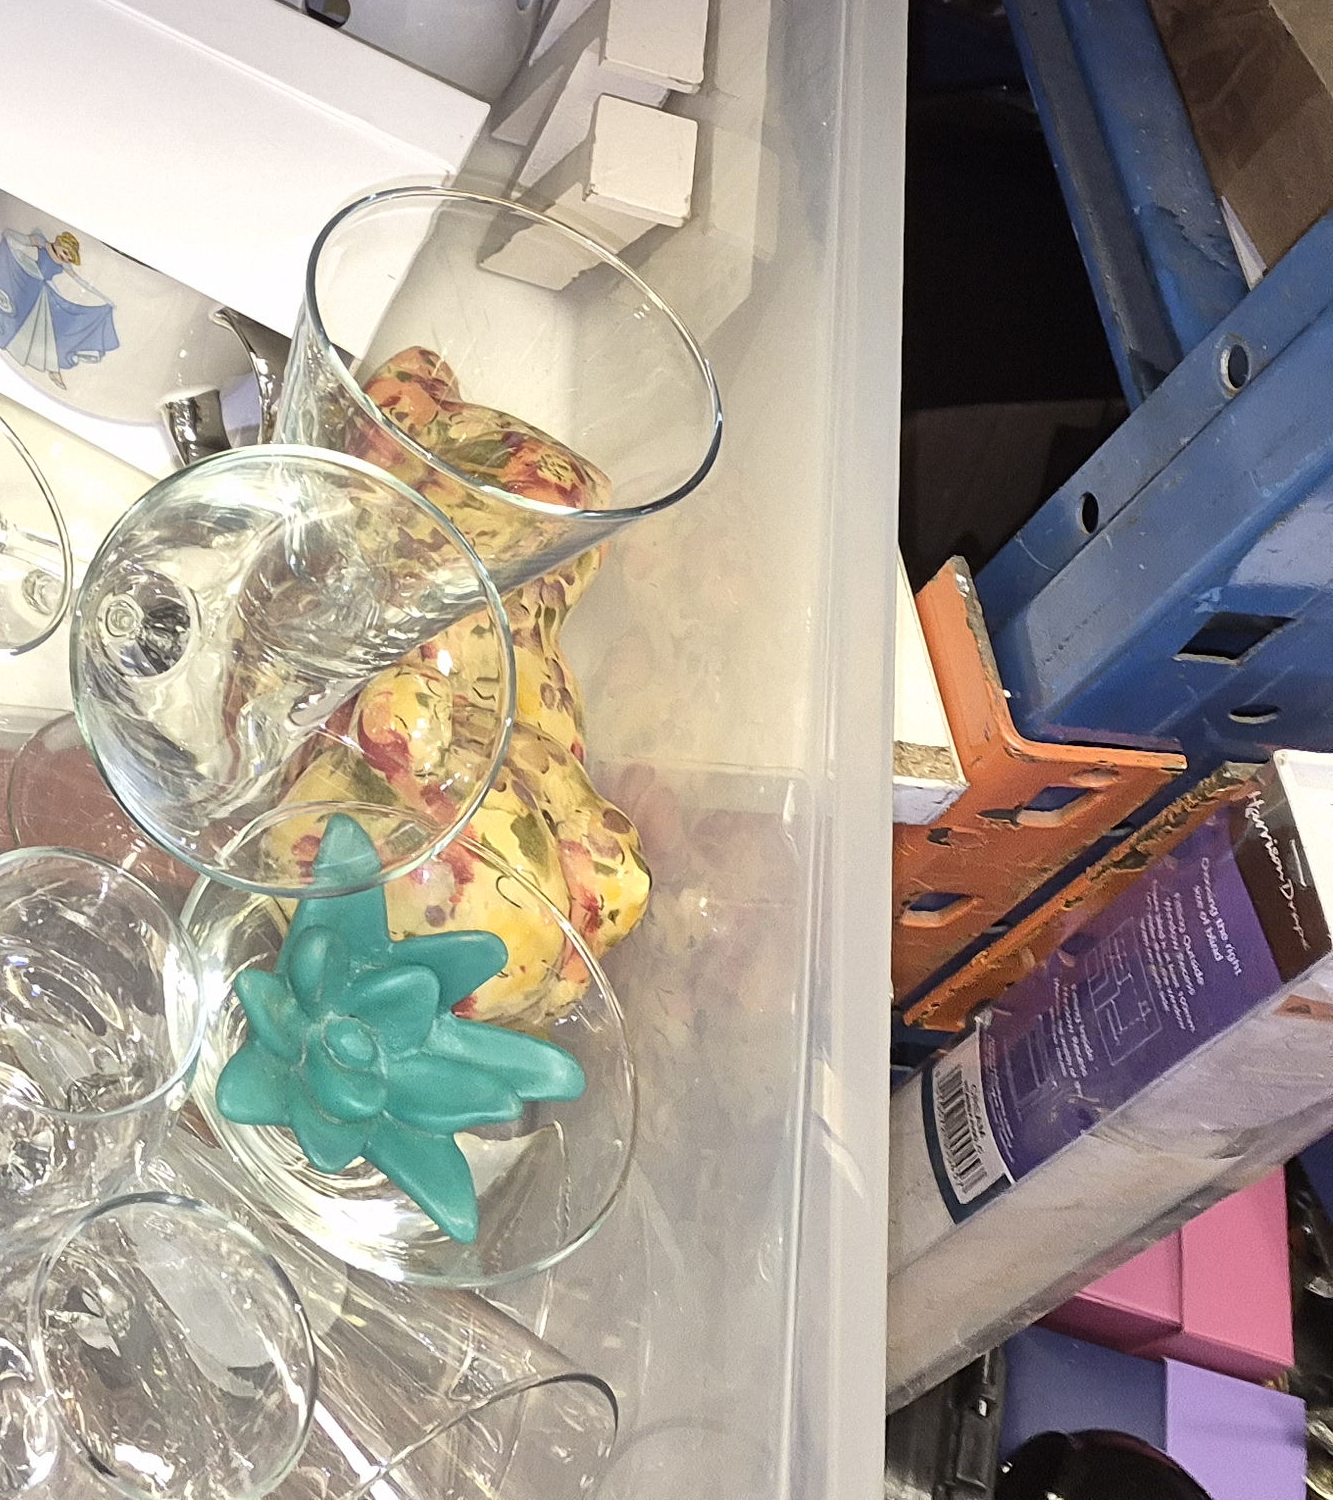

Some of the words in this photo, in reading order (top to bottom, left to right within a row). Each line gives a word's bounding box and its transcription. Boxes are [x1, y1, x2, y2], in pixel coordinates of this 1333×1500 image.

[1199, 910, 1210, 926] of
[1204, 926, 1224, 962] blind
[1215, 917, 1229, 941] the
[1224, 942, 1243, 977] right
